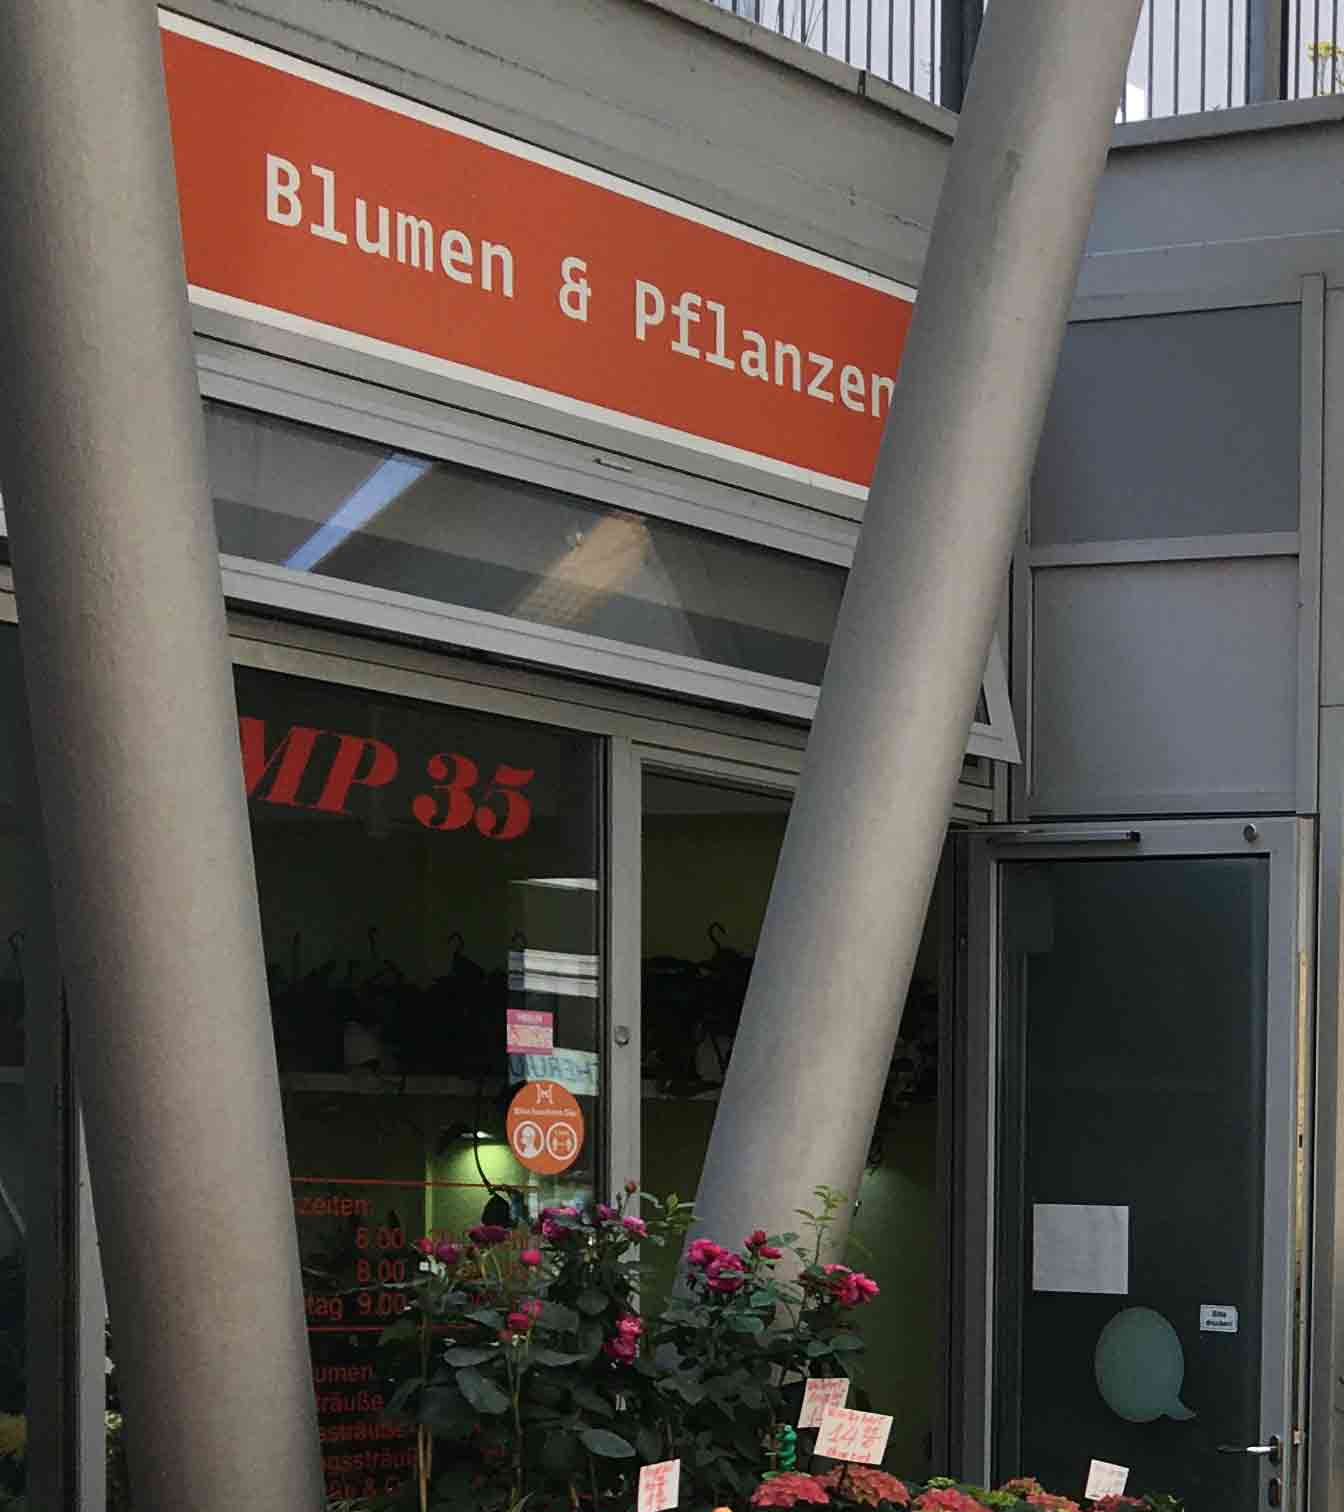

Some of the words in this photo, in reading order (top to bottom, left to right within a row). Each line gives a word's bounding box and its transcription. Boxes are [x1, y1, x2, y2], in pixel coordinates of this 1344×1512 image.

[265, 153, 515, 298] Blumen
[559, 256, 592, 322] &
[635, 279, 897, 418] Pflanzen
[412, 752, 536, 840] 35
